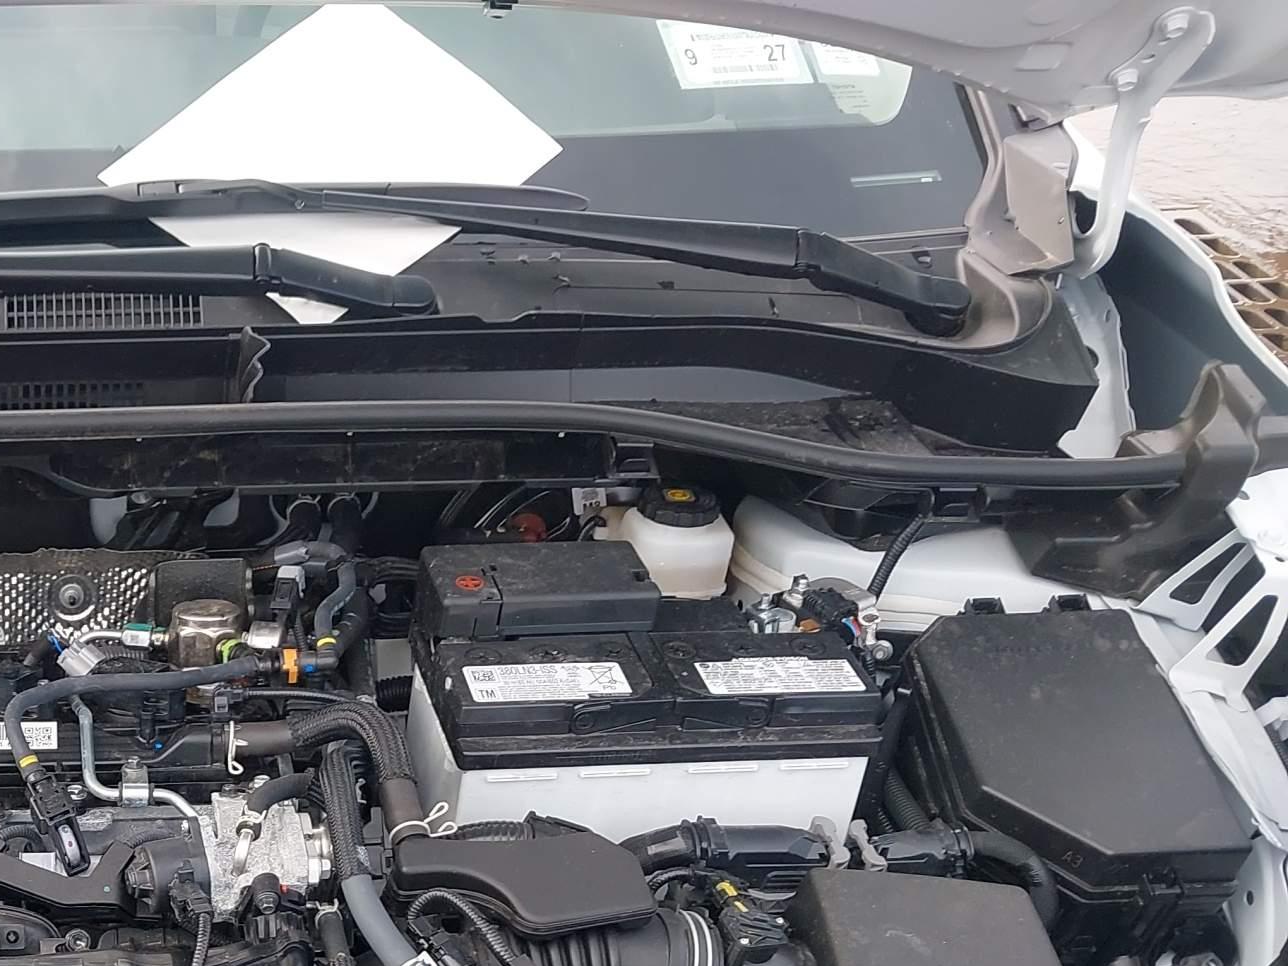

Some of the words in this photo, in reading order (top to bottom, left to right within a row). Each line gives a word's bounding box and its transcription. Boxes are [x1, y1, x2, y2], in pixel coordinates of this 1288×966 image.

[684, 48, 698, 65] 9
[763, 44, 786, 62] 27
[478, 689, 497, 699] TM
